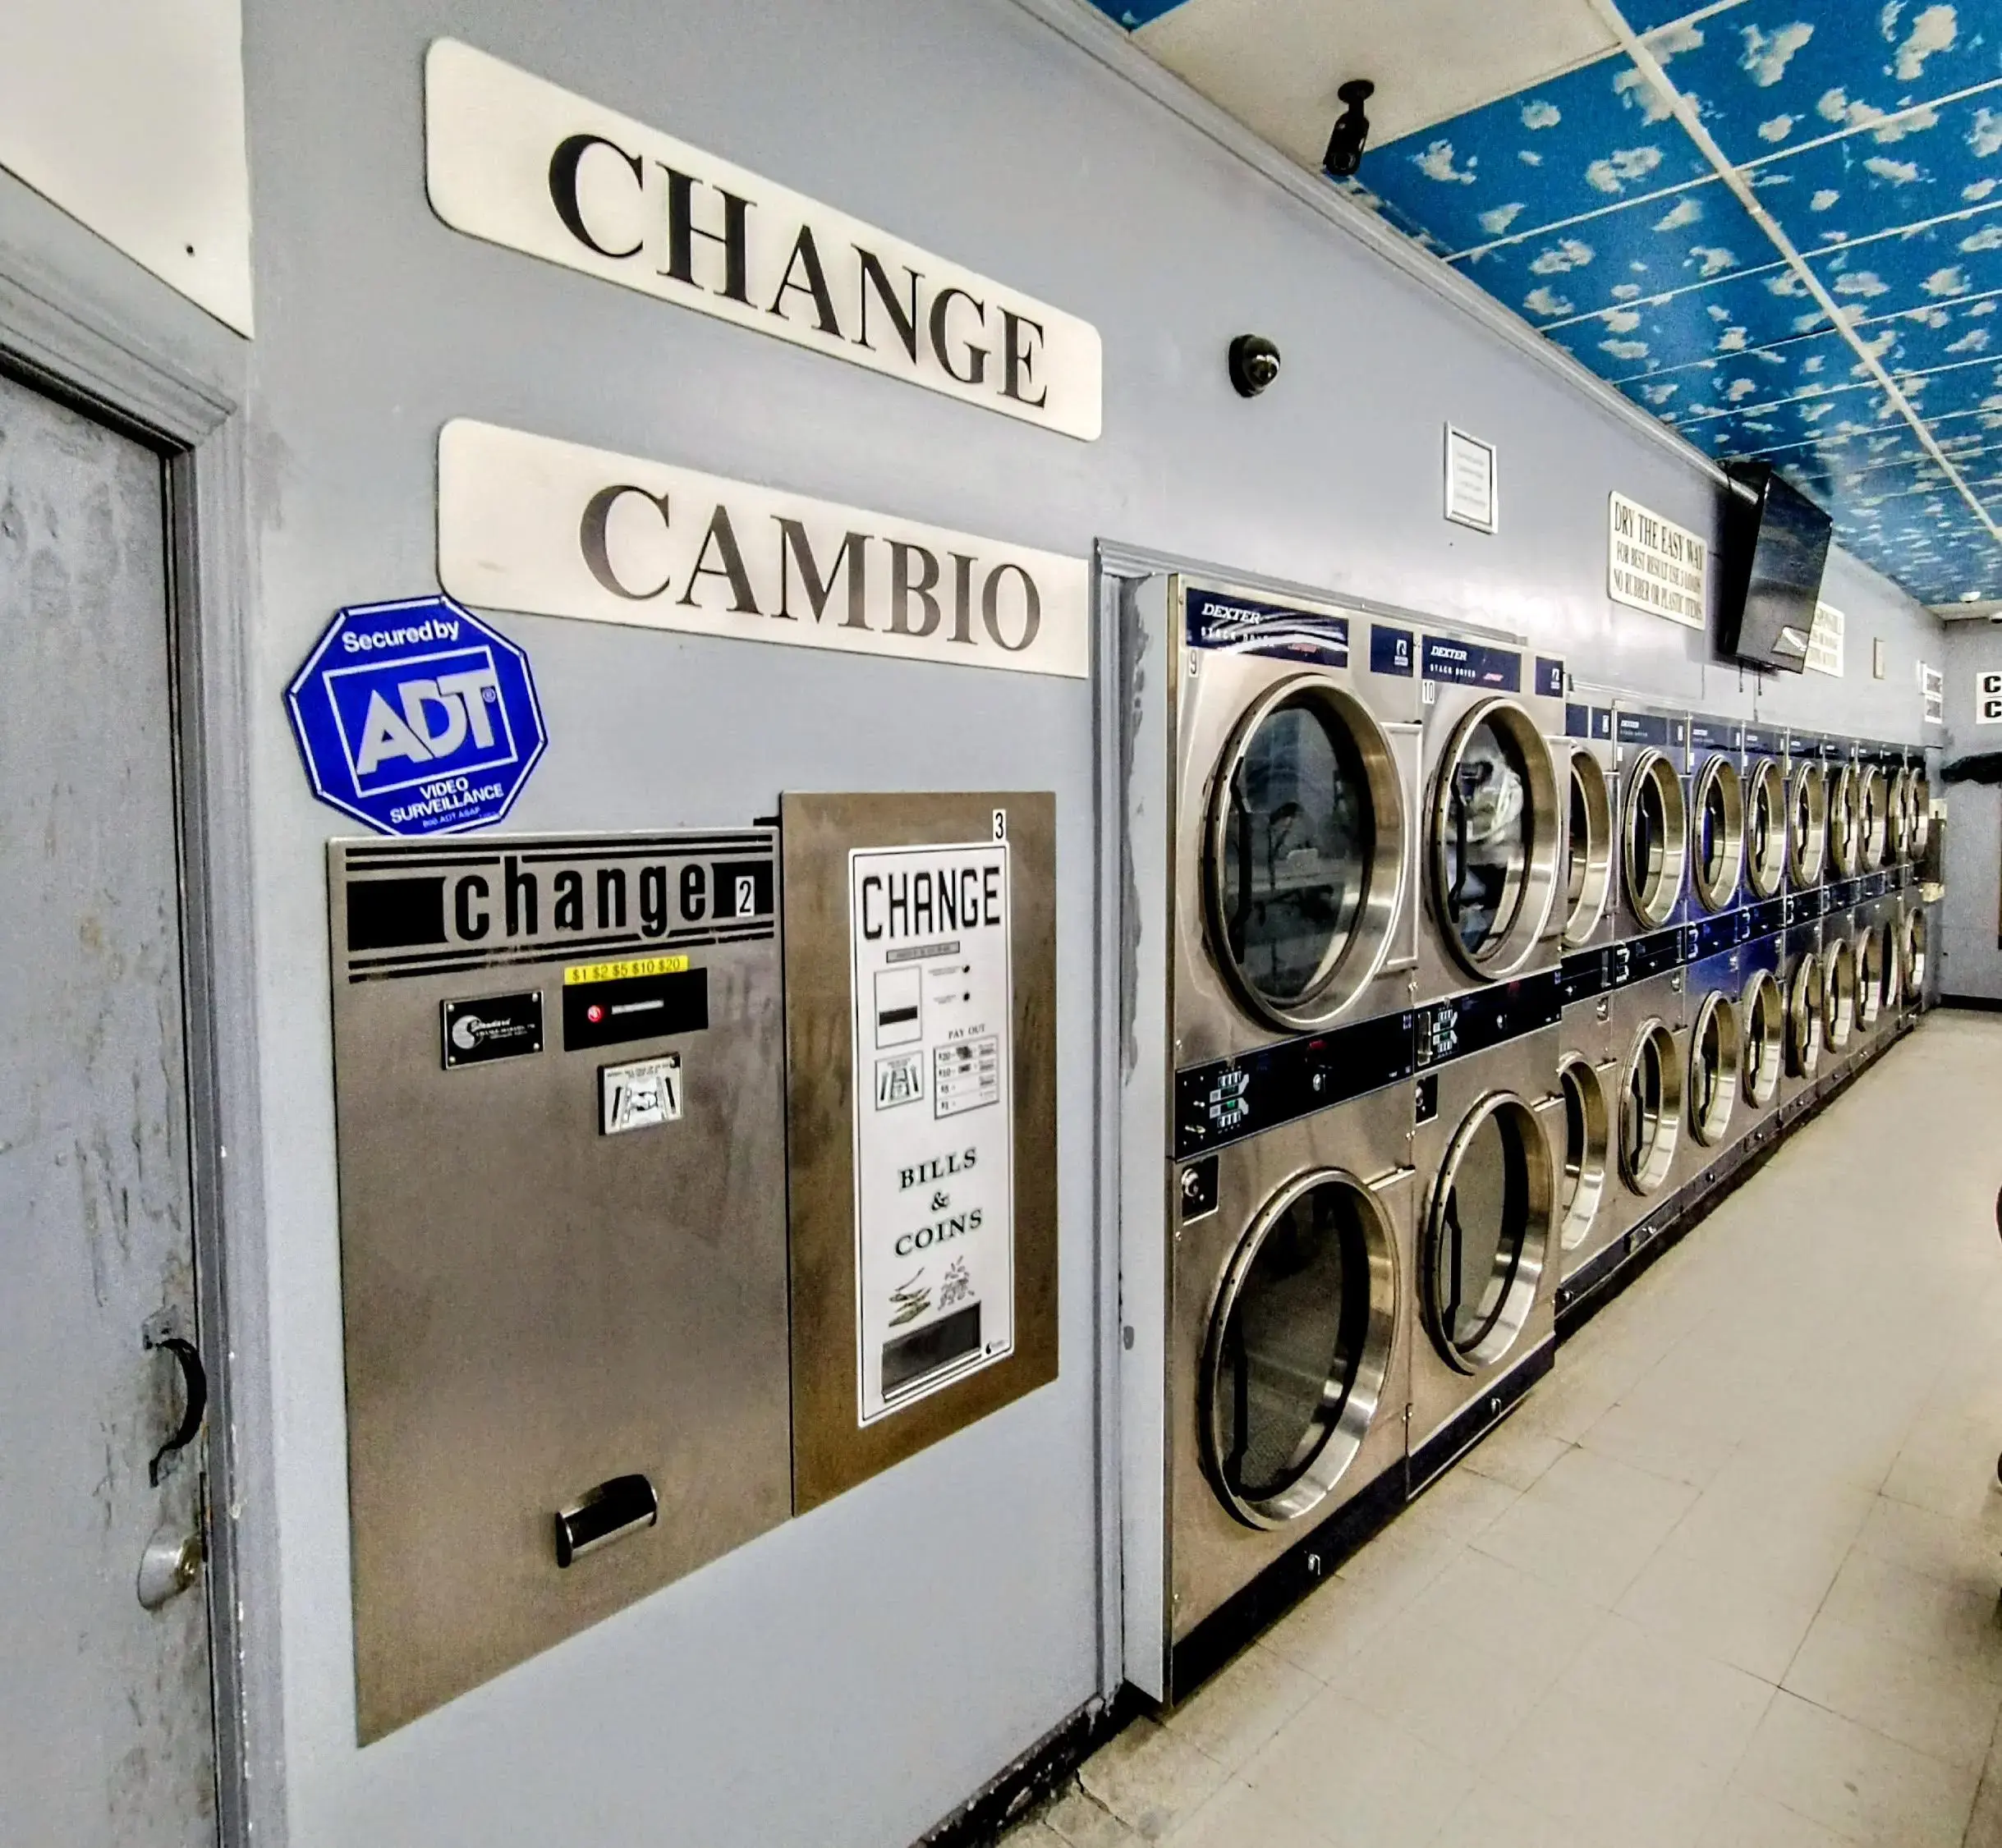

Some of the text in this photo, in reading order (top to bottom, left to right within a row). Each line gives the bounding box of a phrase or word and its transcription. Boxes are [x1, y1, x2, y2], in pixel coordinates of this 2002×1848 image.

[549, 133, 1049, 409] CHANGE
[1614, 501, 1704, 571] DRY THE EASY WAY
[1617, 540, 1629, 564] FOR
[580, 485, 1041, 653] CAMBIO
[1614, 568, 1623, 591] NO
[1201, 603, 1261, 625] DEXTER
[342, 619, 459, 653] Secured by
[1191, 650, 1197, 675] 9
[1430, 645, 1468, 661] DEXTER
[1423, 681, 1435, 703] 10
[356, 667, 498, 776] ADT
[390, 782, 504, 824] SURVEILLANCE
[419, 777, 469, 800] VIDEO
[995, 812, 1003, 839] 3
[454, 855, 705, 942] change
[738, 880, 753, 915] 2
[862, 866, 1000, 941] CHANGE
[572, 957, 681, 982] $1 $2 $5 $10 $20
[948, 1023, 985, 1040] PAY OUT
[899, 1148, 977, 1192] BILLS
[931, 1191, 949, 1211] &
[895, 1208, 982, 1256] COINS
